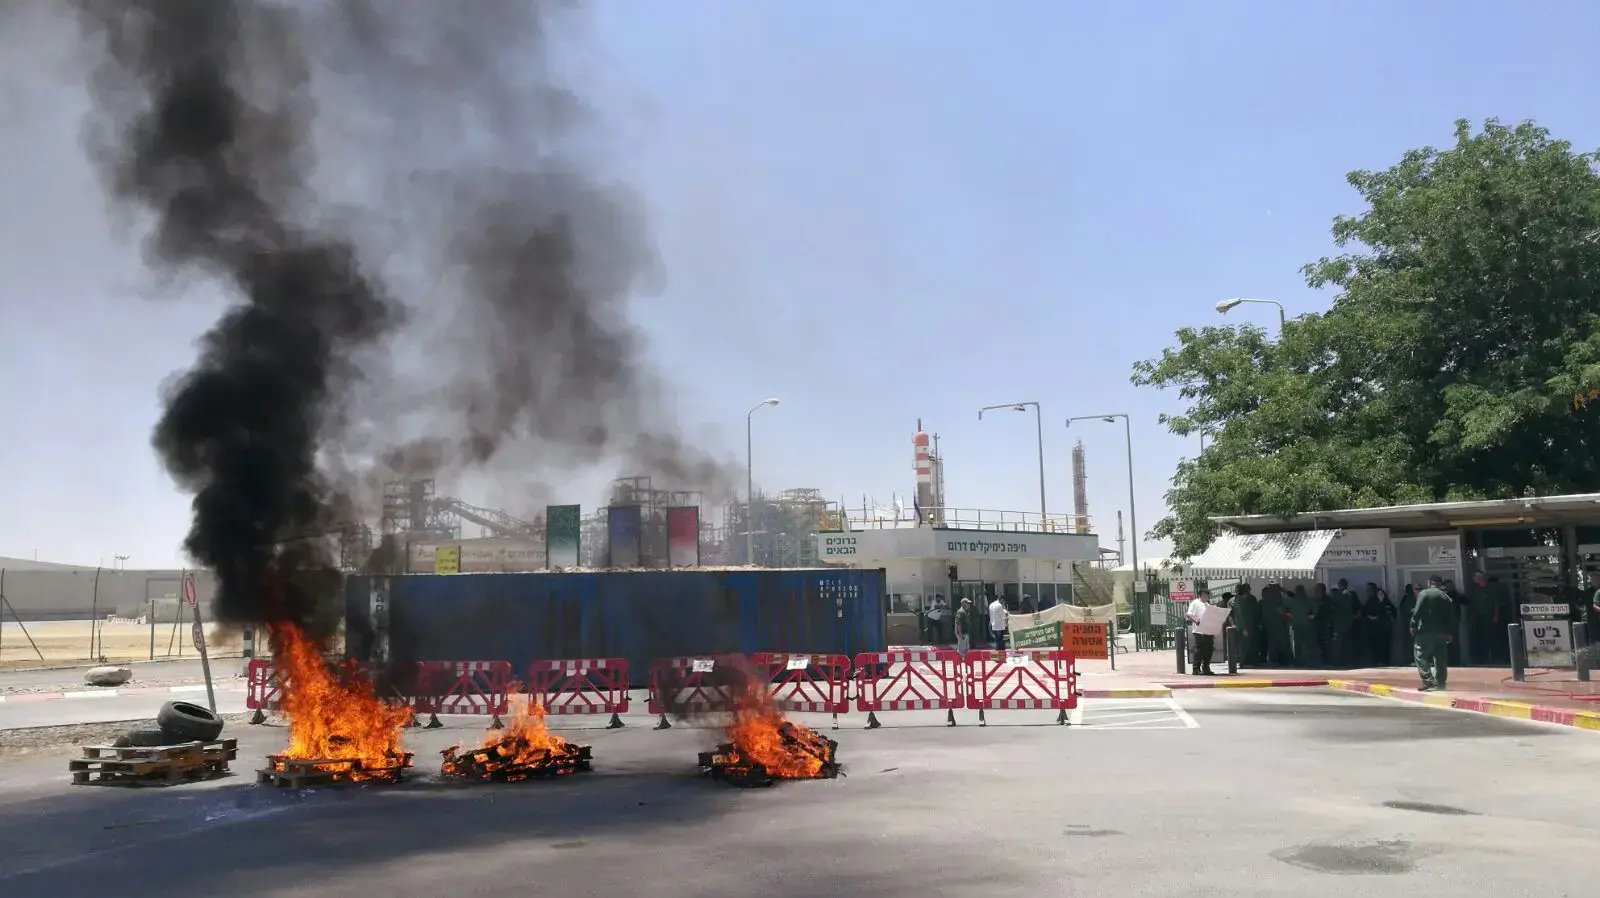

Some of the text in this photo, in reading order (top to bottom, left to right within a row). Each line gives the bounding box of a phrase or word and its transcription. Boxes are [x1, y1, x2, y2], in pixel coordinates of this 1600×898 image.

[826, 537, 857, 545] ברוכים
[947, 540, 1027, 554] חיפה כימיקלים דרום
[1530, 605, 1549, 613] אסורה
[1072, 624, 1102, 634] החניה
[1072, 636, 1103, 646] אסורה
